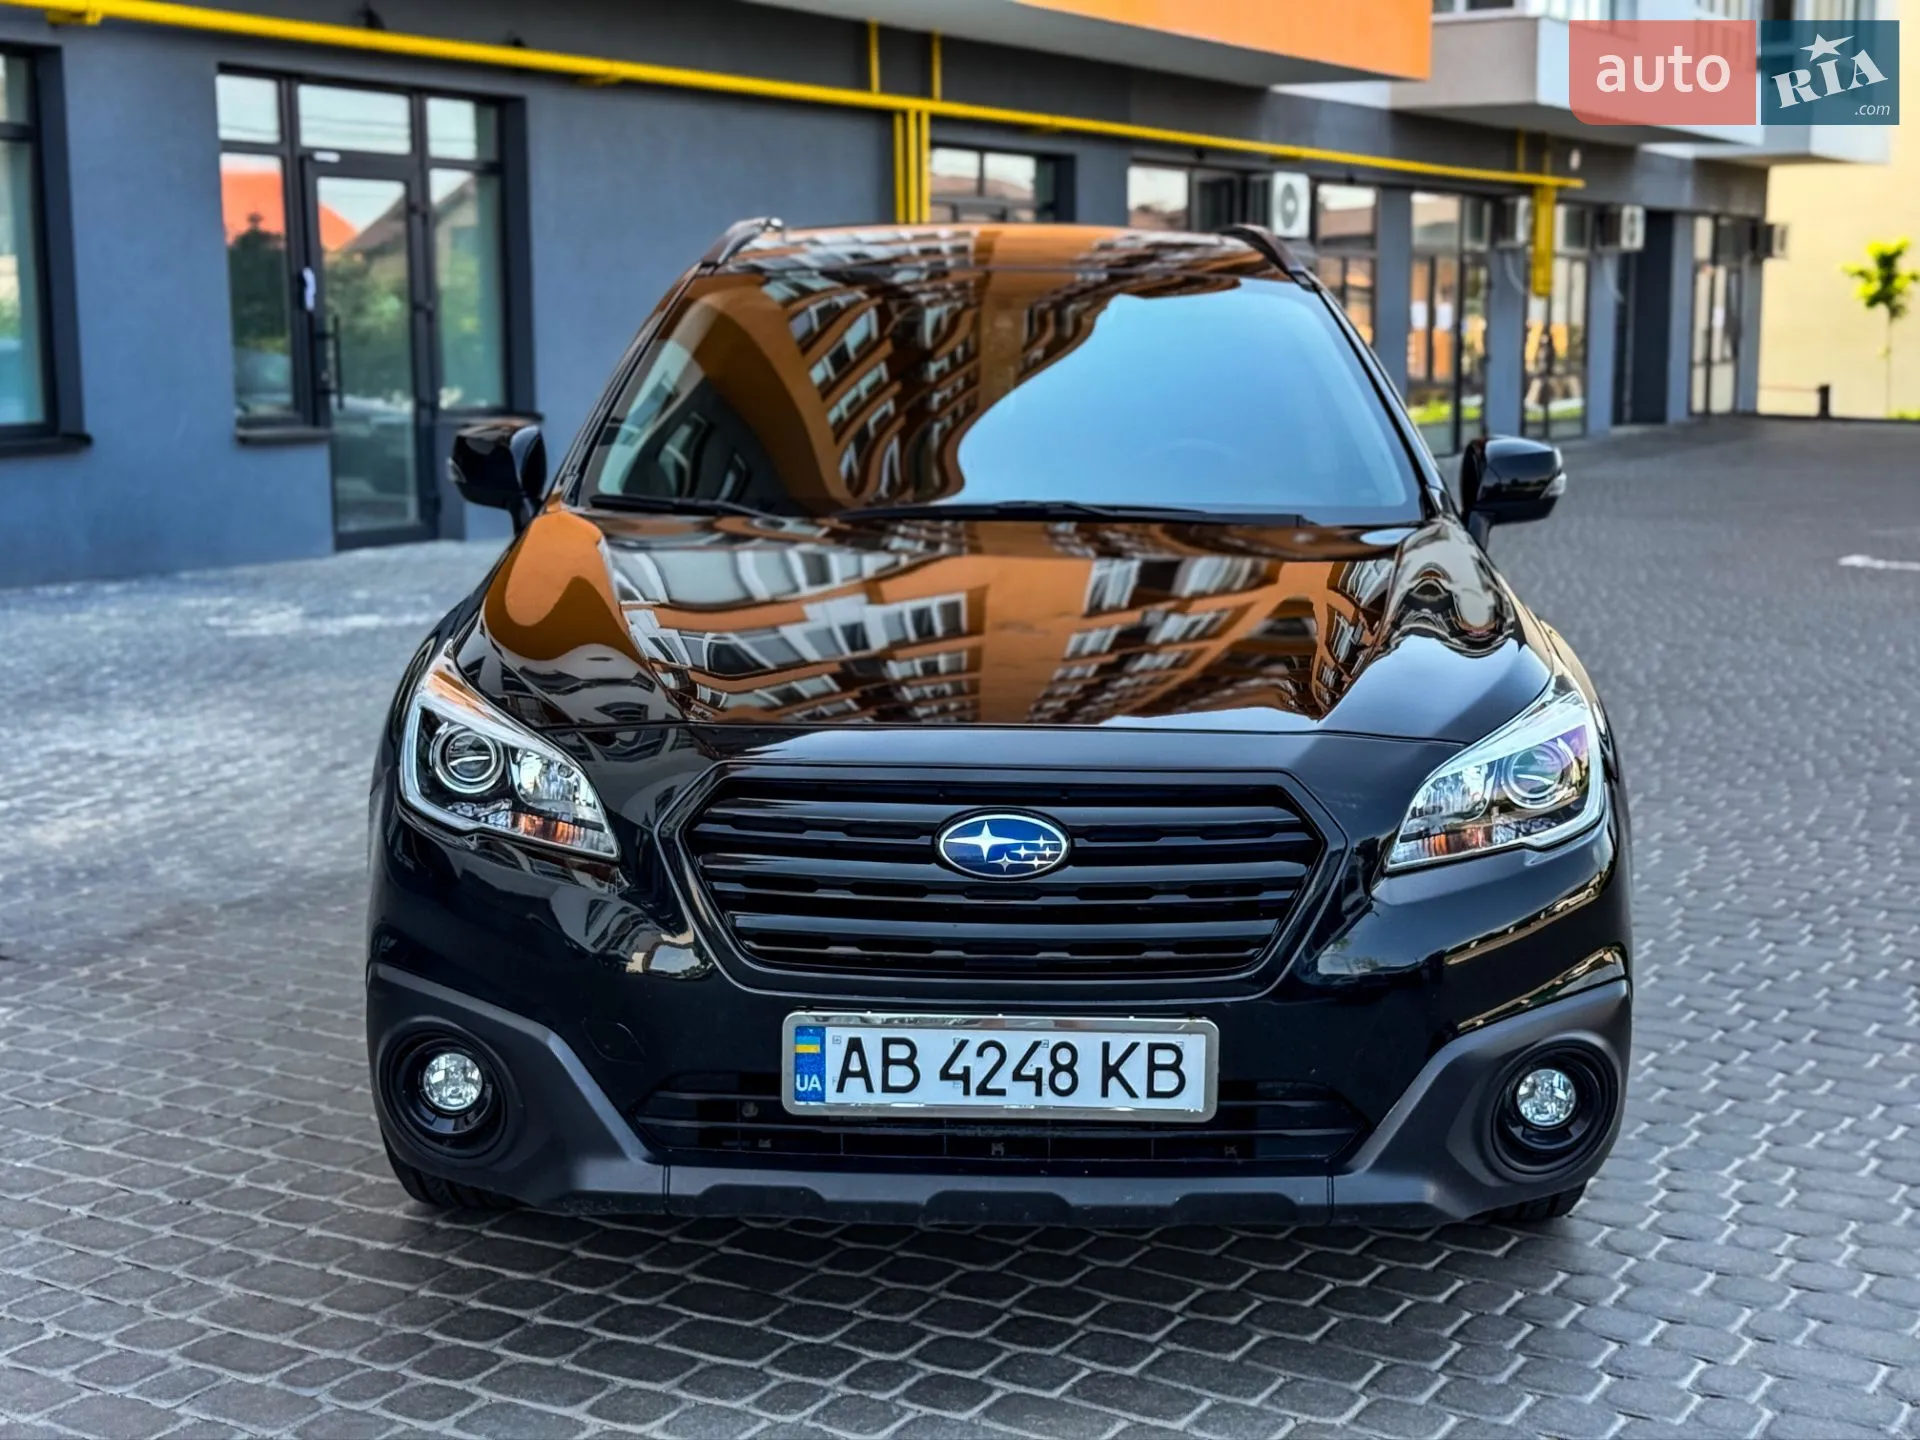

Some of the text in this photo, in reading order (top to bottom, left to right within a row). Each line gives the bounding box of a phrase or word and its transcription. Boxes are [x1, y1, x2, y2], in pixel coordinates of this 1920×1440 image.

[796, 1075, 821, 1092] UA
[835, 1037, 1187, 1099] AB 4248 KB
